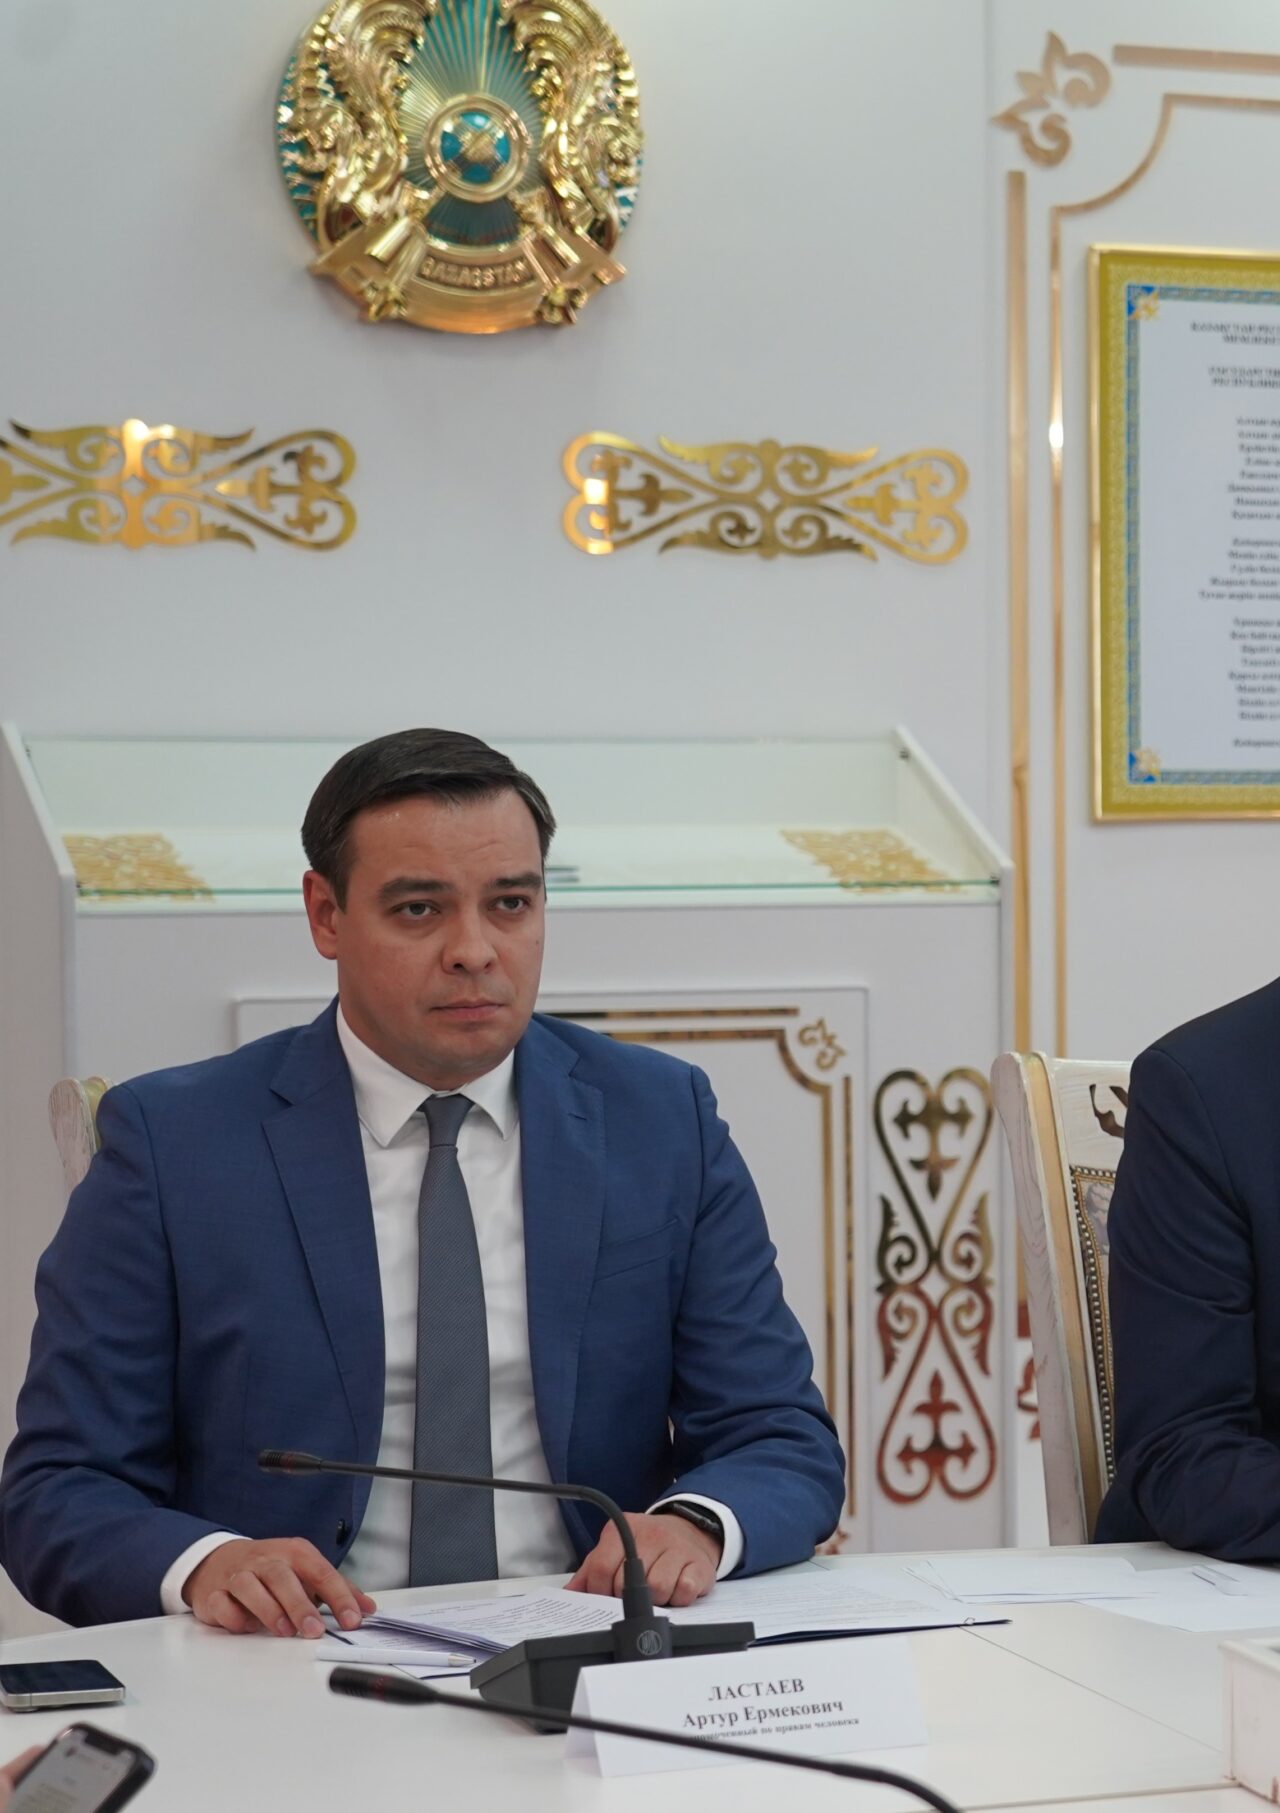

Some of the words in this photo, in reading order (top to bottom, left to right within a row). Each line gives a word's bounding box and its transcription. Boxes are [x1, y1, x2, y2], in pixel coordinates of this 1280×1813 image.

[708, 1678, 805, 1701] ЛАСТАЕВ
[682, 1711, 739, 1730] Артур
[744, 1701, 844, 1724] Ермекович
[776, 1723, 812, 1735] правам
[815, 1718, 860, 1728] человека
